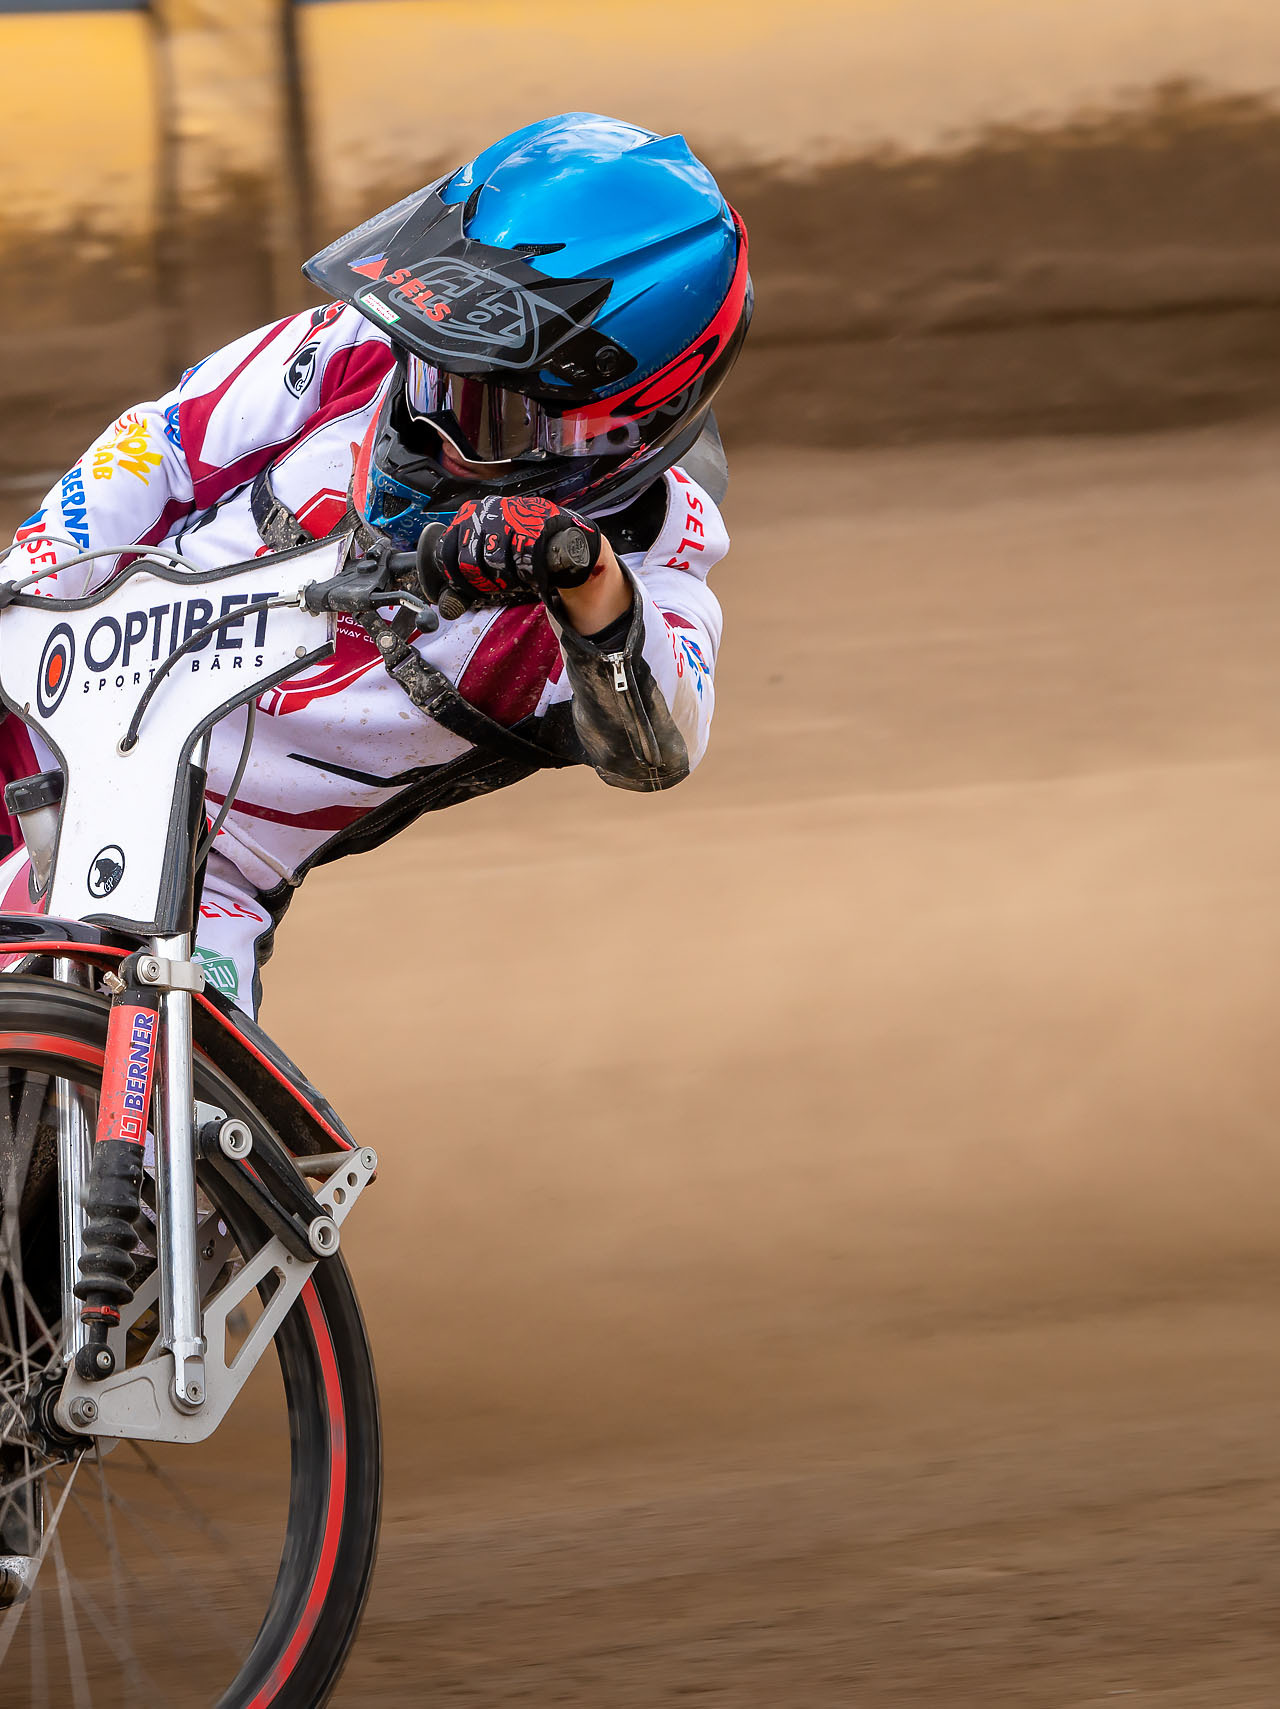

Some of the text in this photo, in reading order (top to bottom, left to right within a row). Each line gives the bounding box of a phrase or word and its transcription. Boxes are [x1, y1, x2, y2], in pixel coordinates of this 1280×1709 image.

[386, 269, 451, 321] SELS
[61, 467, 90, 554] BERNE
[84, 592, 279, 672] OPTIBET
[83, 655, 263, 693] SPORT BĀRS
[200, 902, 263, 922] ELS
[124, 1013, 154, 1112] BERNER
